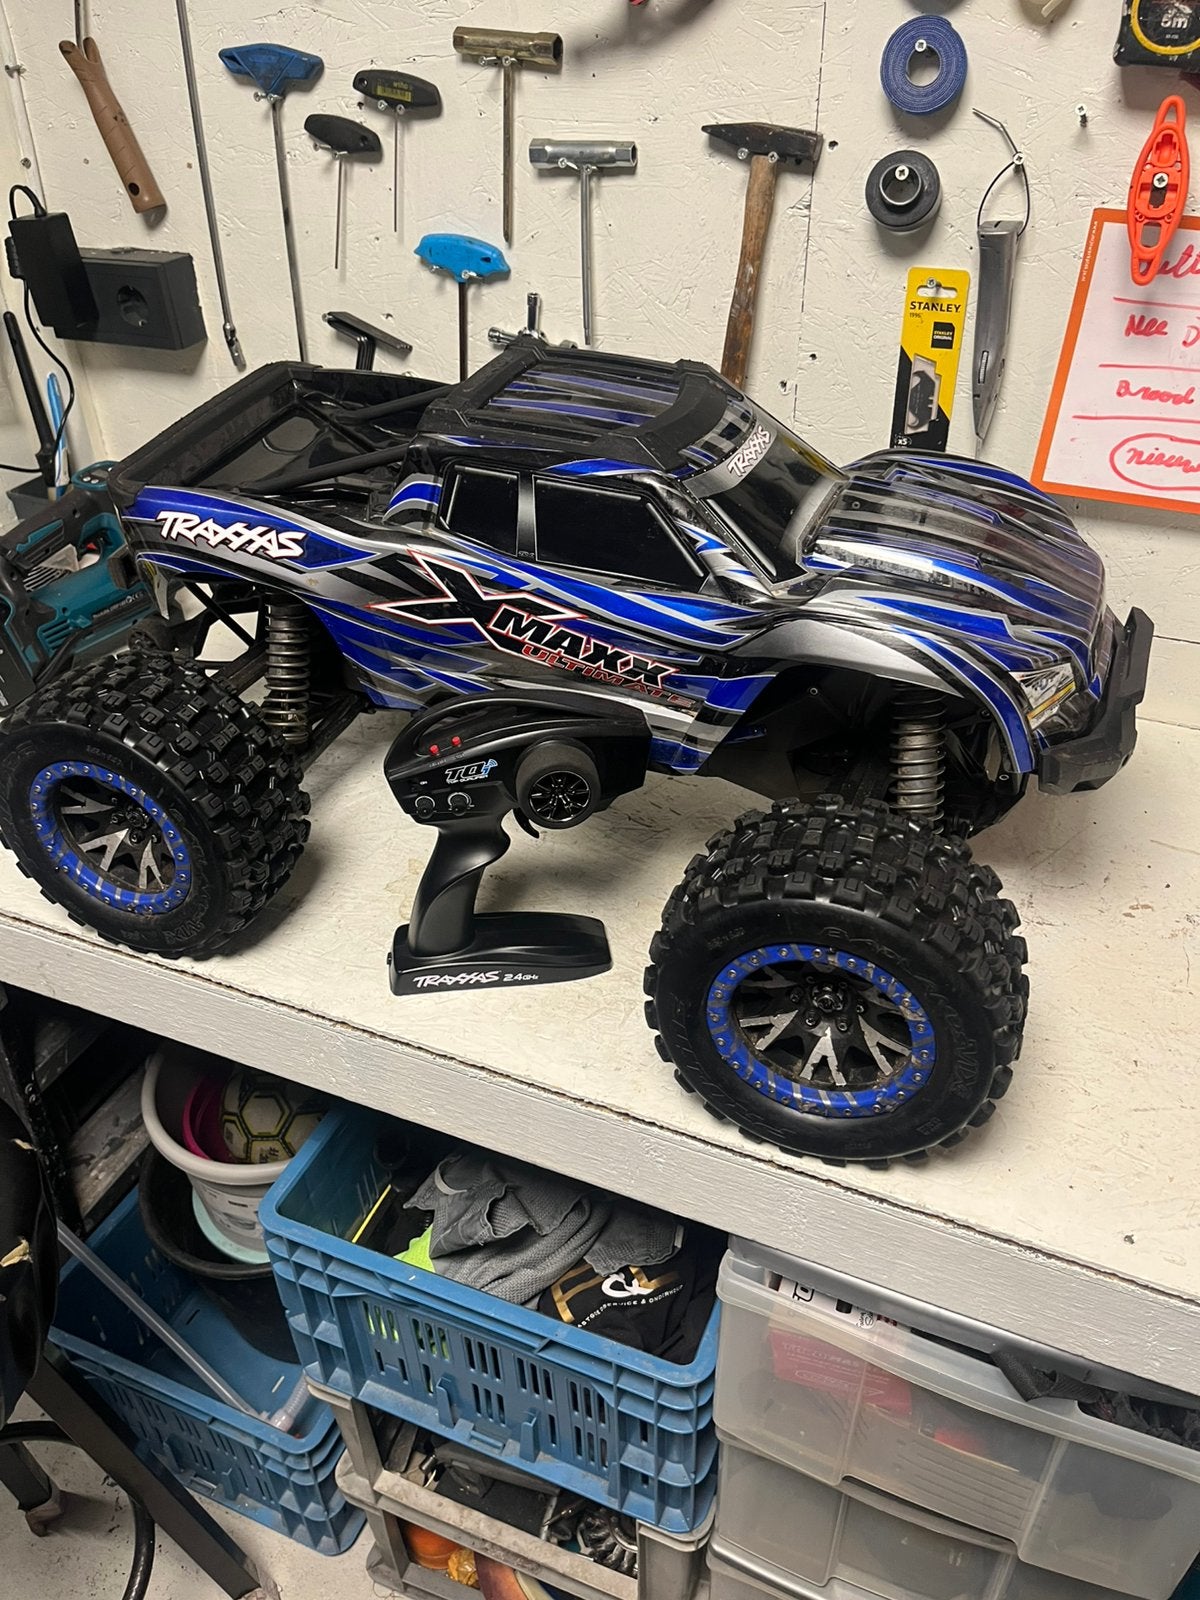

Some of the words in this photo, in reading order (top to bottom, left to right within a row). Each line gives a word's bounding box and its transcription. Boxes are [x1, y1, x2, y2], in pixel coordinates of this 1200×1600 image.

[909, 301, 961, 313] STANLEY
[727, 424, 770, 477] TRAXXAS
[156, 510, 307, 559] TRAXXAS
[488, 603, 680, 690] MAXX
[521, 643, 698, 707] ULTIMATE
[413, 971, 500, 988] TRAXXAS
